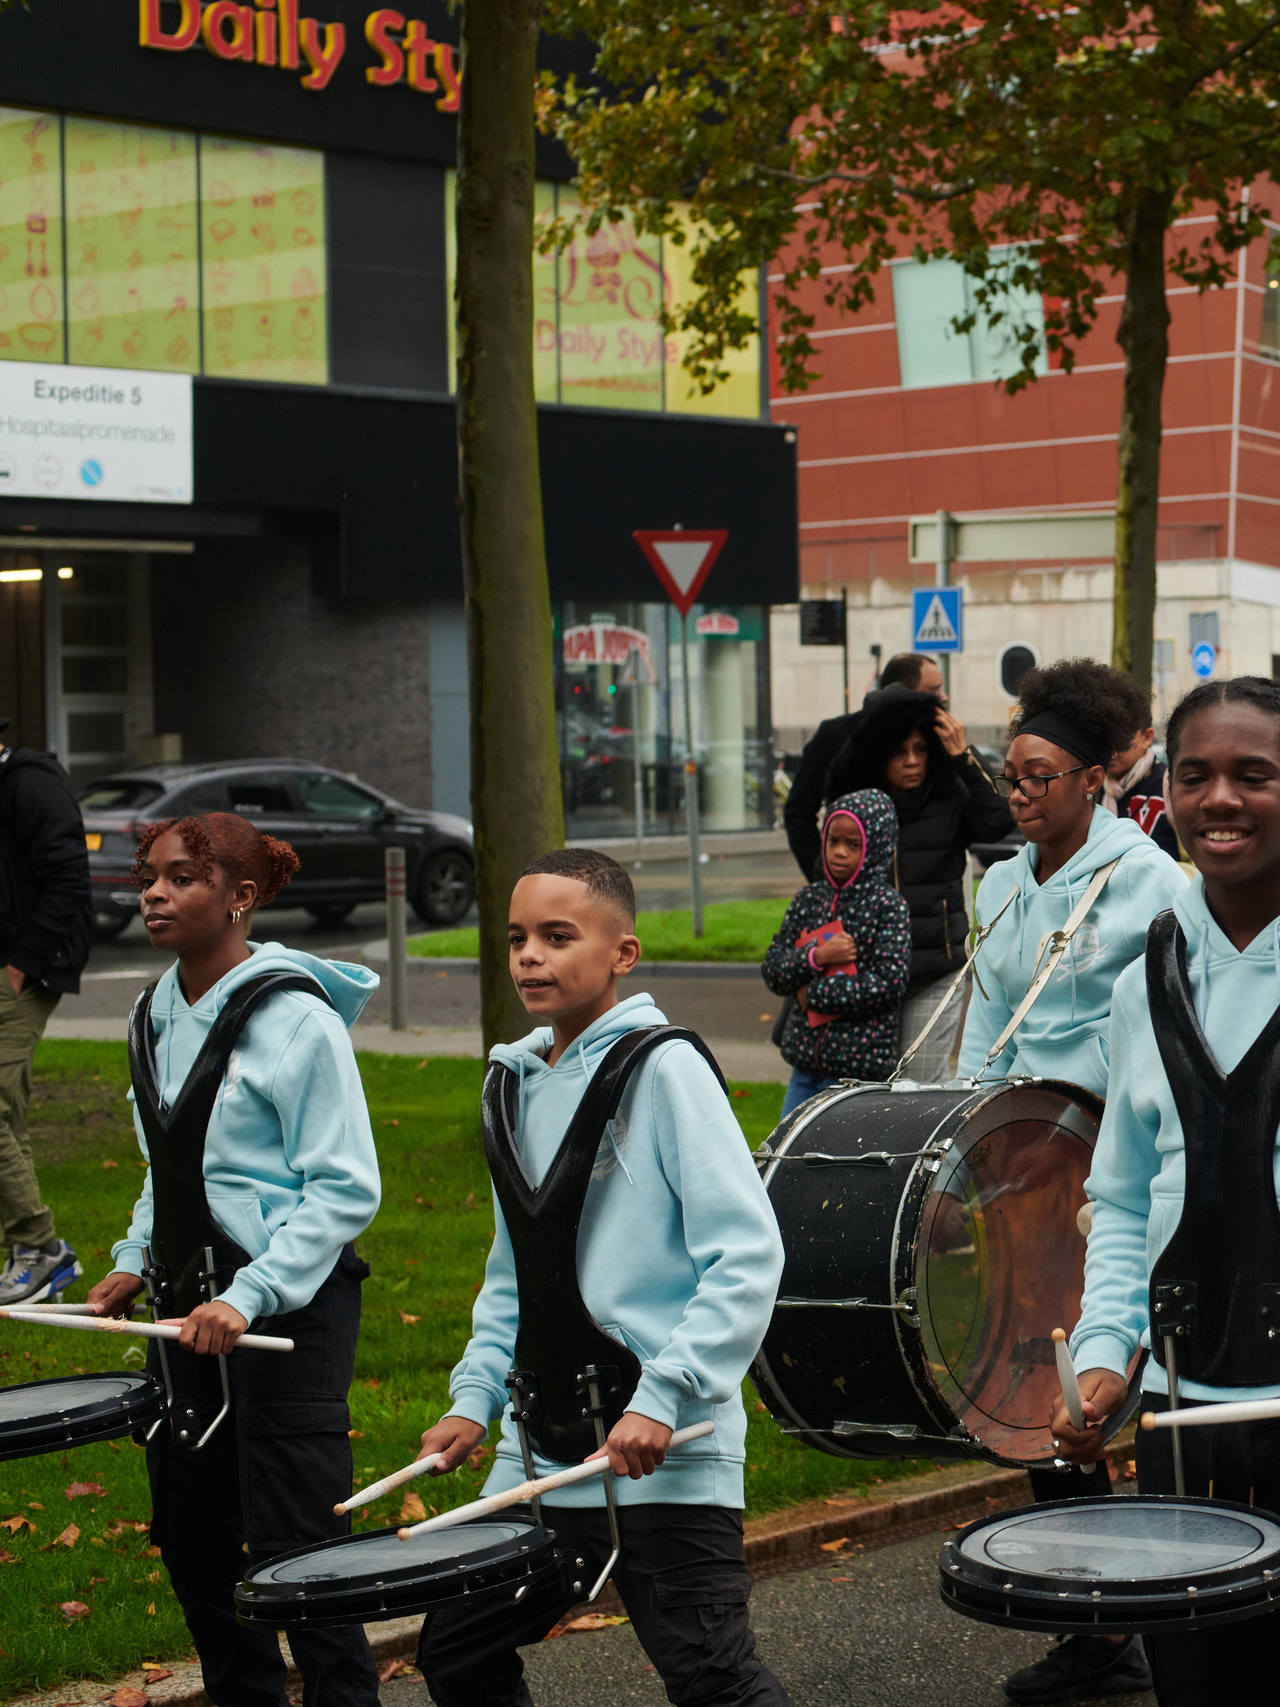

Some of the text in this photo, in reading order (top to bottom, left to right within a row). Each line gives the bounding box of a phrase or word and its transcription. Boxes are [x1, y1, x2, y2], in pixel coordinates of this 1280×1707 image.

[139, 0, 461, 112] Daily Sty
[536, 319, 678, 367] Daily Style
[34, 380, 142, 405] Expeditie 5
